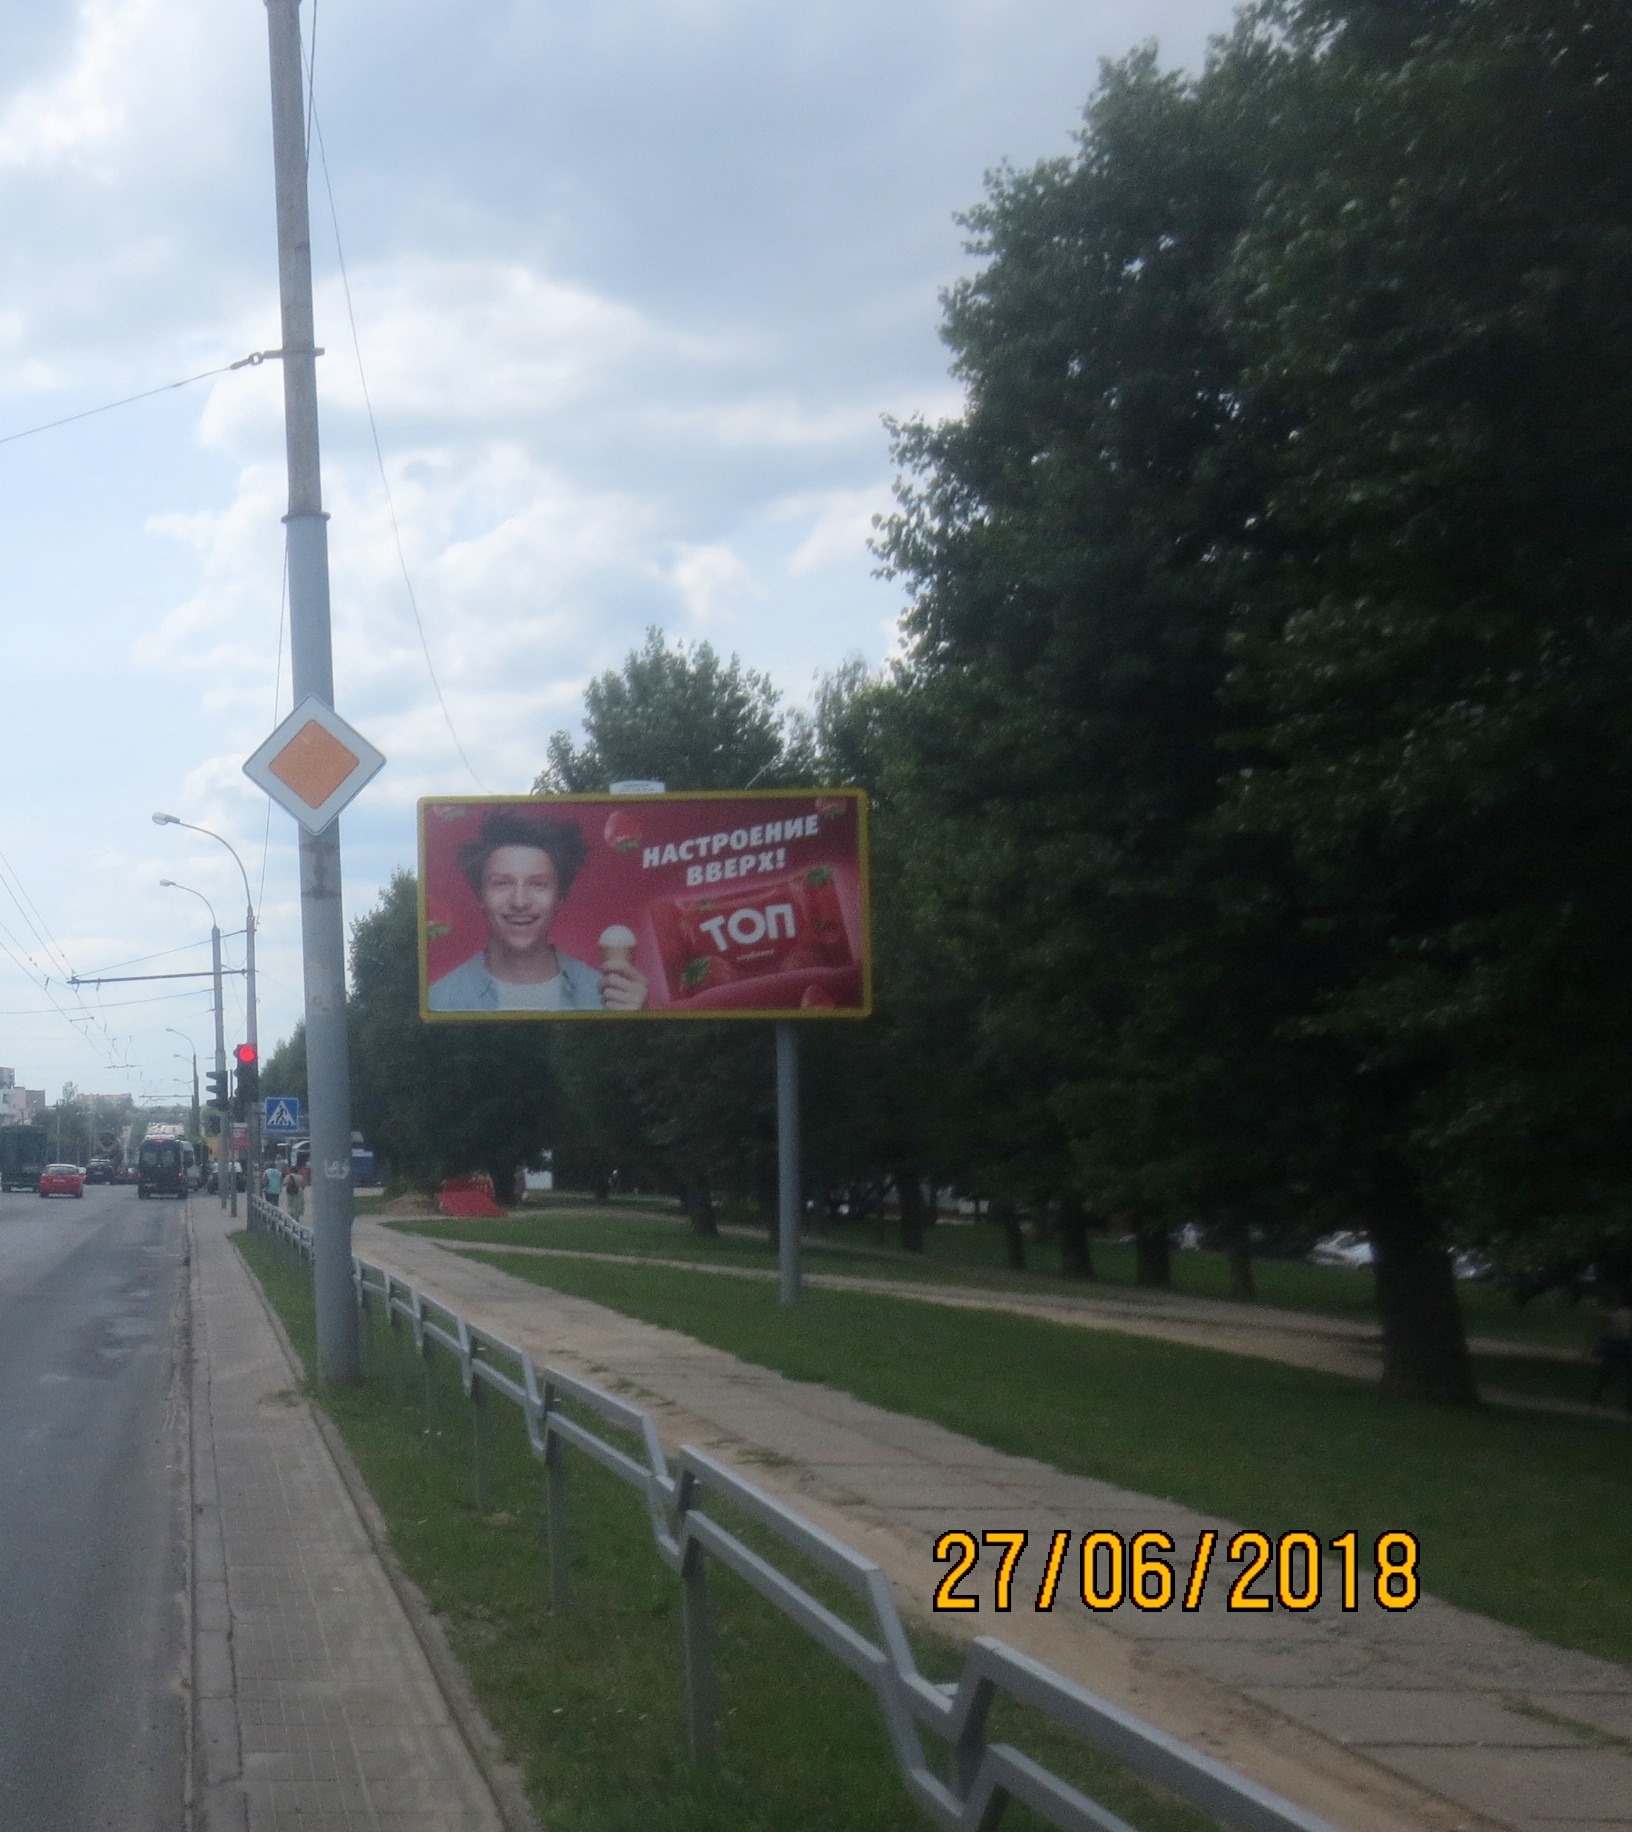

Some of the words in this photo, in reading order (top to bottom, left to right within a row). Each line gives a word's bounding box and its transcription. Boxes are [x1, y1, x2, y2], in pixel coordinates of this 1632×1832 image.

[642, 814, 819, 869] НАСТРОЕНИЕ
[686, 848, 786, 887] ВВЕРХ!
[699, 903, 796, 952] ТОП
